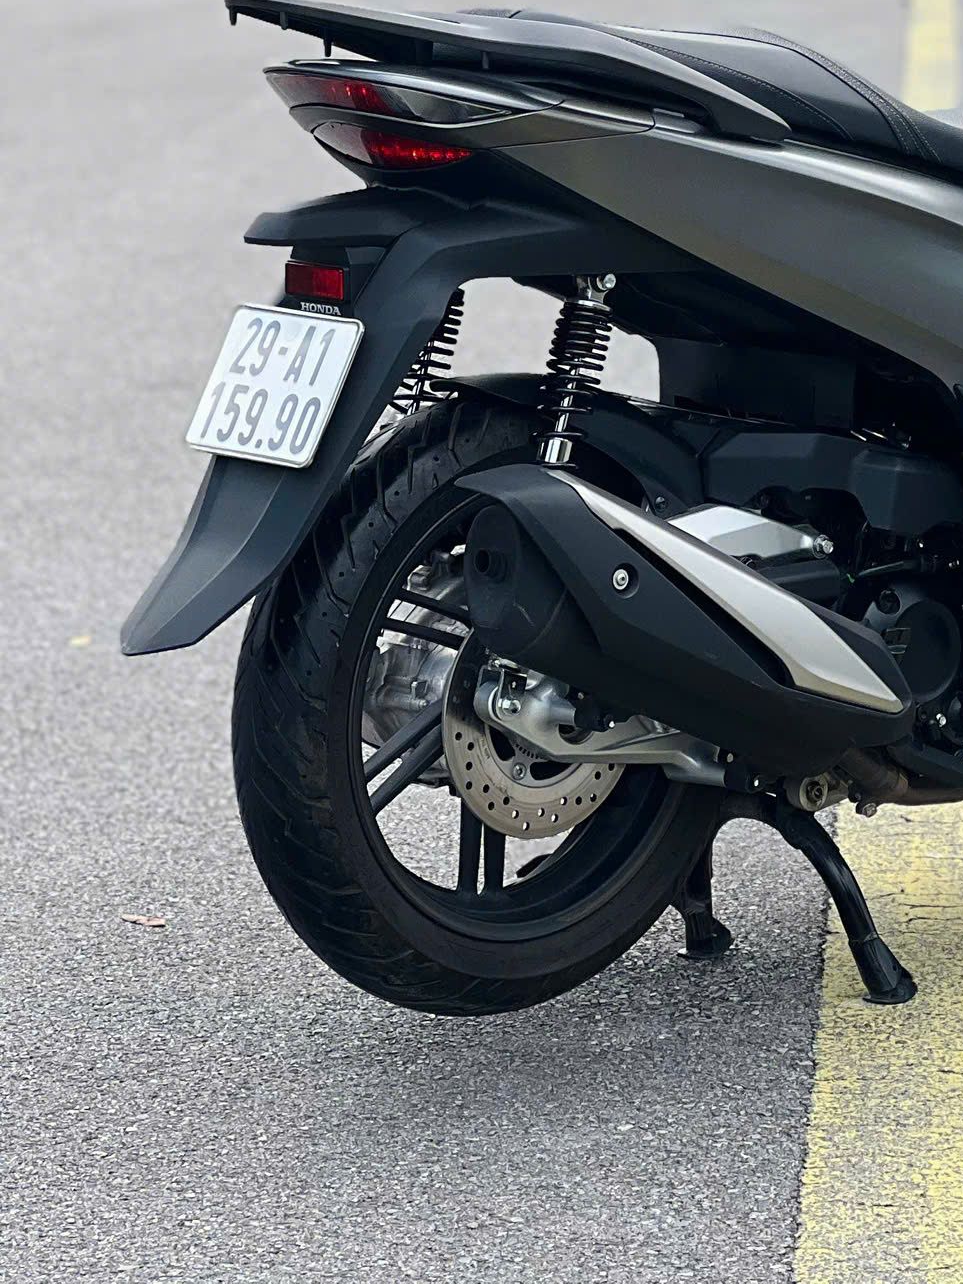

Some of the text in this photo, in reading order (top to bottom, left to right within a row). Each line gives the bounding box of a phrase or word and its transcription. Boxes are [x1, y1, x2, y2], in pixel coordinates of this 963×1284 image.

[300, 302, 341, 315] HONDA
[229, 317, 336, 387] 29-A1
[200, 381, 321, 455] 159.90
